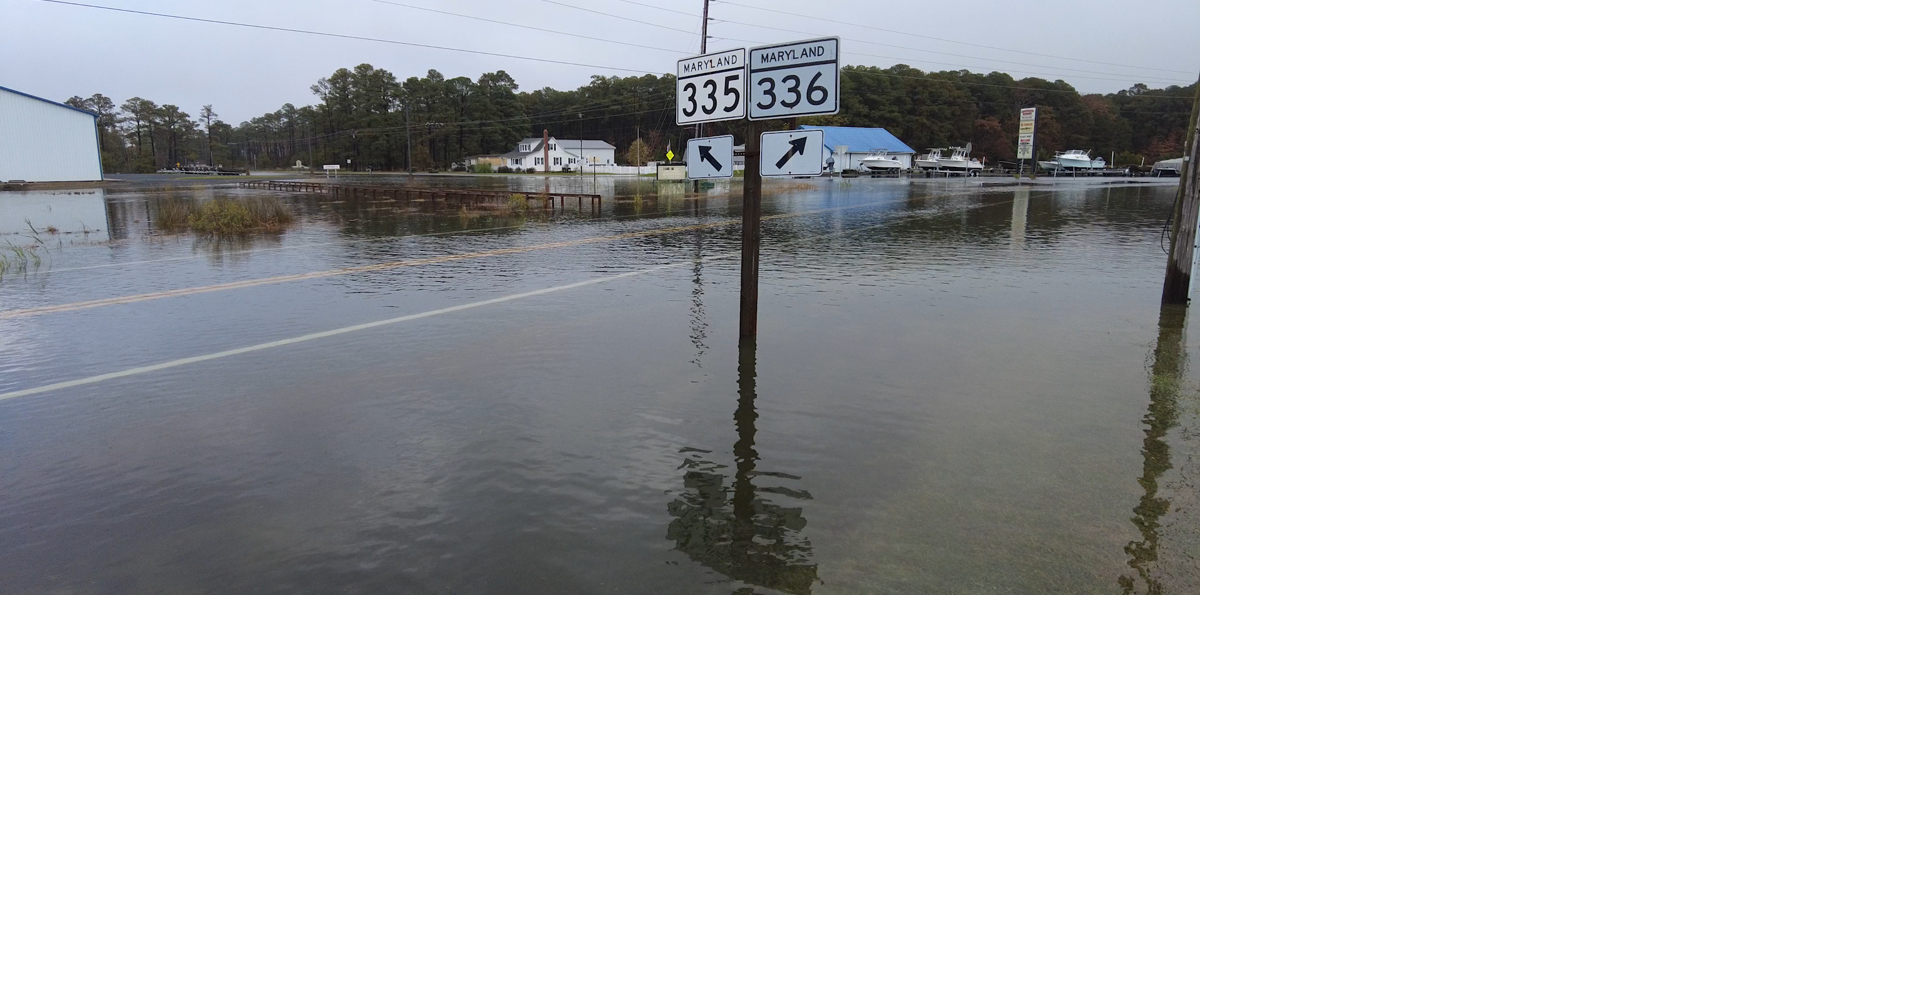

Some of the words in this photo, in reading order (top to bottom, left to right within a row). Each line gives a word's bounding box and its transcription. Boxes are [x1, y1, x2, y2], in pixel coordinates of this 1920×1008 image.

[683, 54, 738, 73] MARYLAND
[761, 45, 825, 64] MARYLAND
[682, 74, 740, 117] 335
[756, 71, 829, 110] 336
